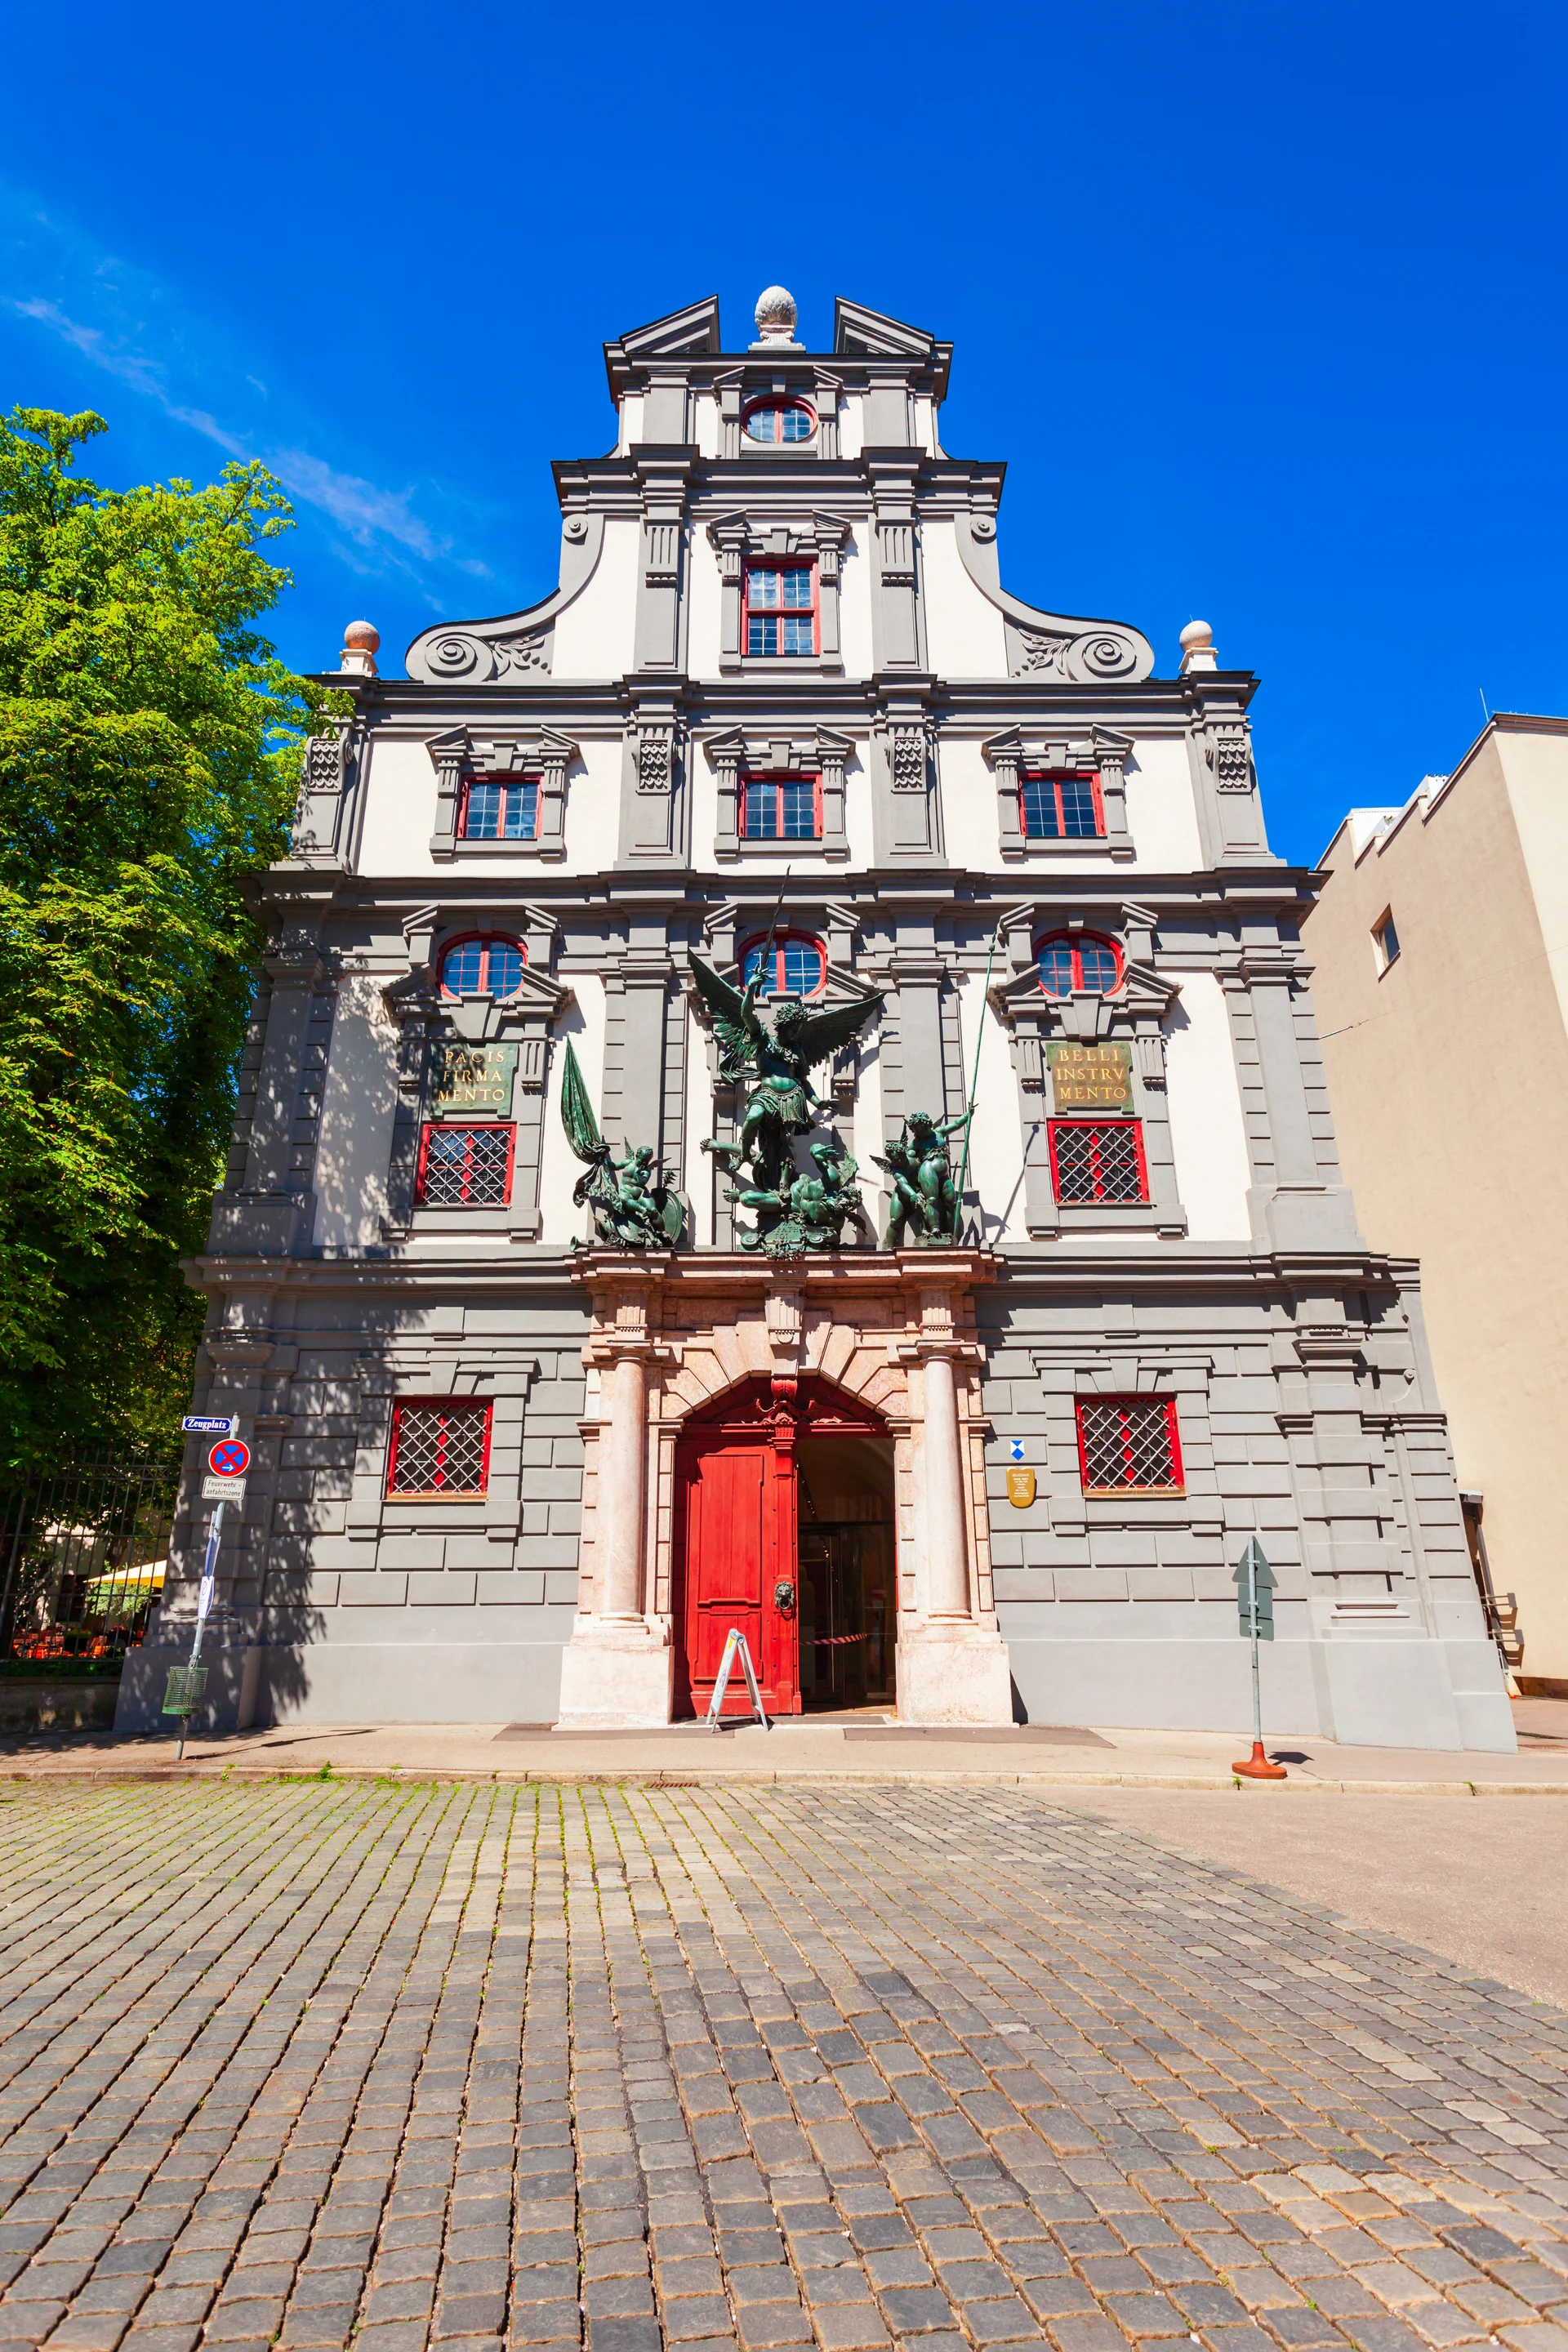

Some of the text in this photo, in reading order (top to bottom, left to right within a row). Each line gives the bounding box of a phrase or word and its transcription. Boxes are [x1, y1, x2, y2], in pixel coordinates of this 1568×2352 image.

[444, 1051, 505, 1063] PACIS
[1059, 1049, 1119, 1062] BELLI
[443, 1070, 502, 1082] FIRMA
[1056, 1068, 1124, 1080] INSTRV
[437, 1089, 505, 1102] MENTO
[1059, 1087, 1126, 1099] MENTO
[187, 1419, 227, 1430] Zeugplatz
[206, 1488, 241, 1496] anfahrtszone
